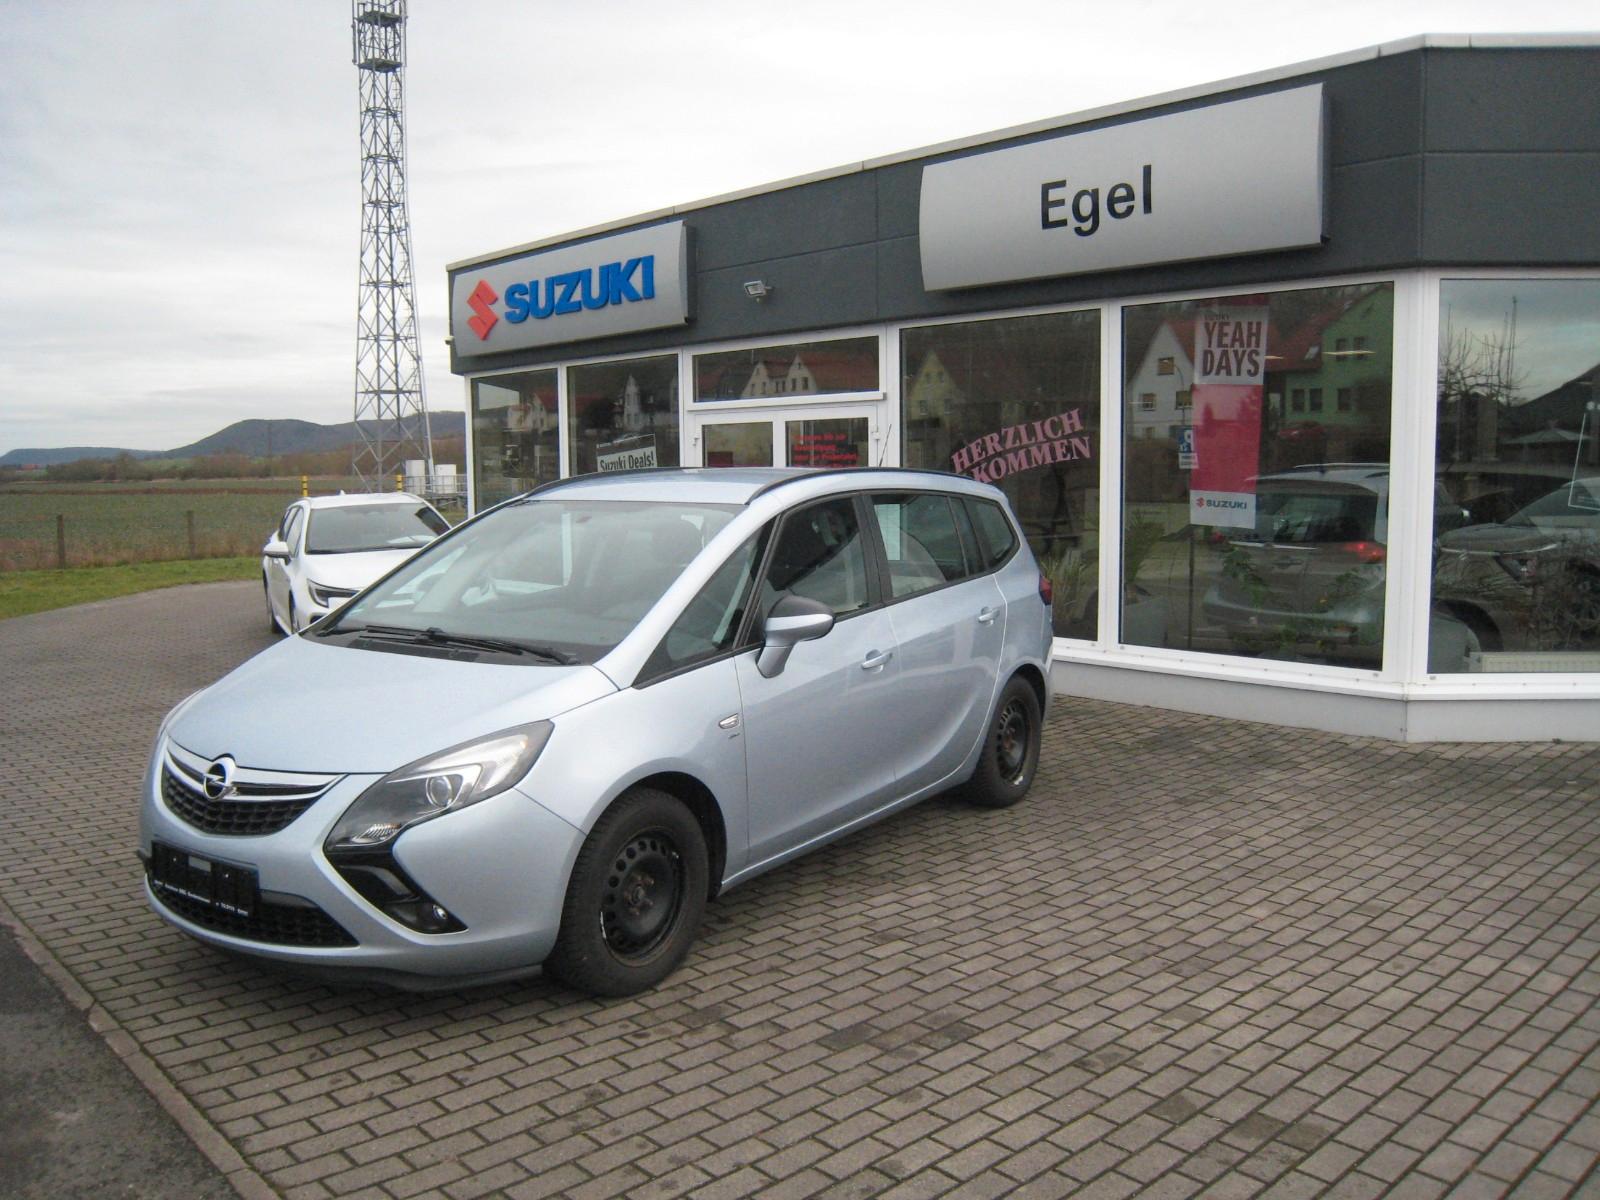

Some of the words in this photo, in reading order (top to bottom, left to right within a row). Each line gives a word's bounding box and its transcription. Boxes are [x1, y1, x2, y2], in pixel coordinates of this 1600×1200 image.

[1041, 164, 1152, 237] Egel
[504, 255, 655, 324] SUZUKI
[1204, 321, 1262, 348] YEAH
[1202, 349, 1260, 377] DAYS
[951, 408, 1084, 474] HERZLICH
[628, 450, 655, 469] Deals!
[1206, 499, 1248, 510] SUZUKI
